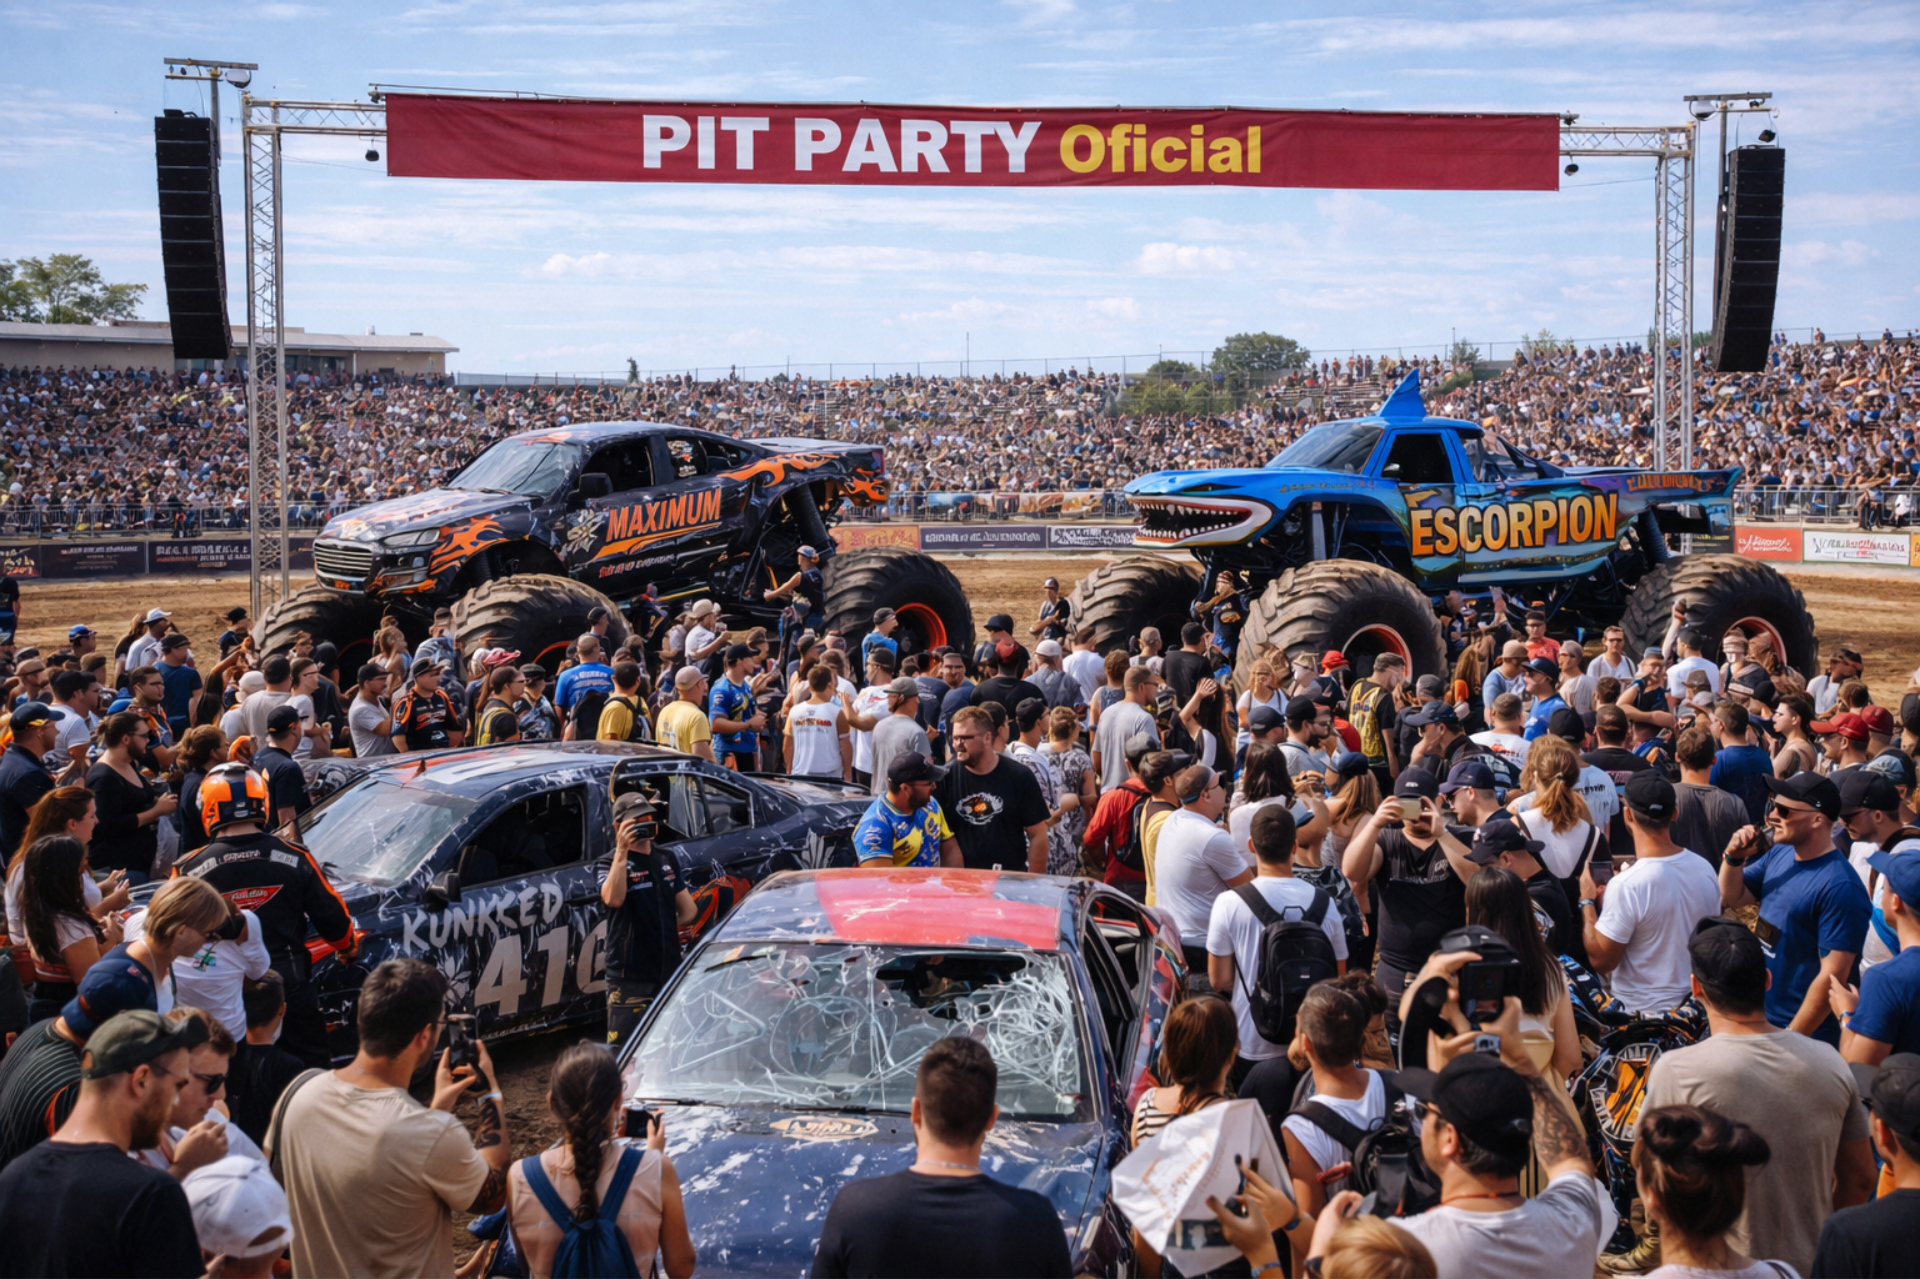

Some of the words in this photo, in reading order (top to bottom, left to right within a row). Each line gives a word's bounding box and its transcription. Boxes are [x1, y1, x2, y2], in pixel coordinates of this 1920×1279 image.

[642, 114, 770, 171] PIT
[794, 117, 1042, 173] PARTY
[1059, 124, 1262, 174] Oficial
[606, 486, 722, 542] MAXIMUM
[1410, 492, 1618, 556] ESCORPION
